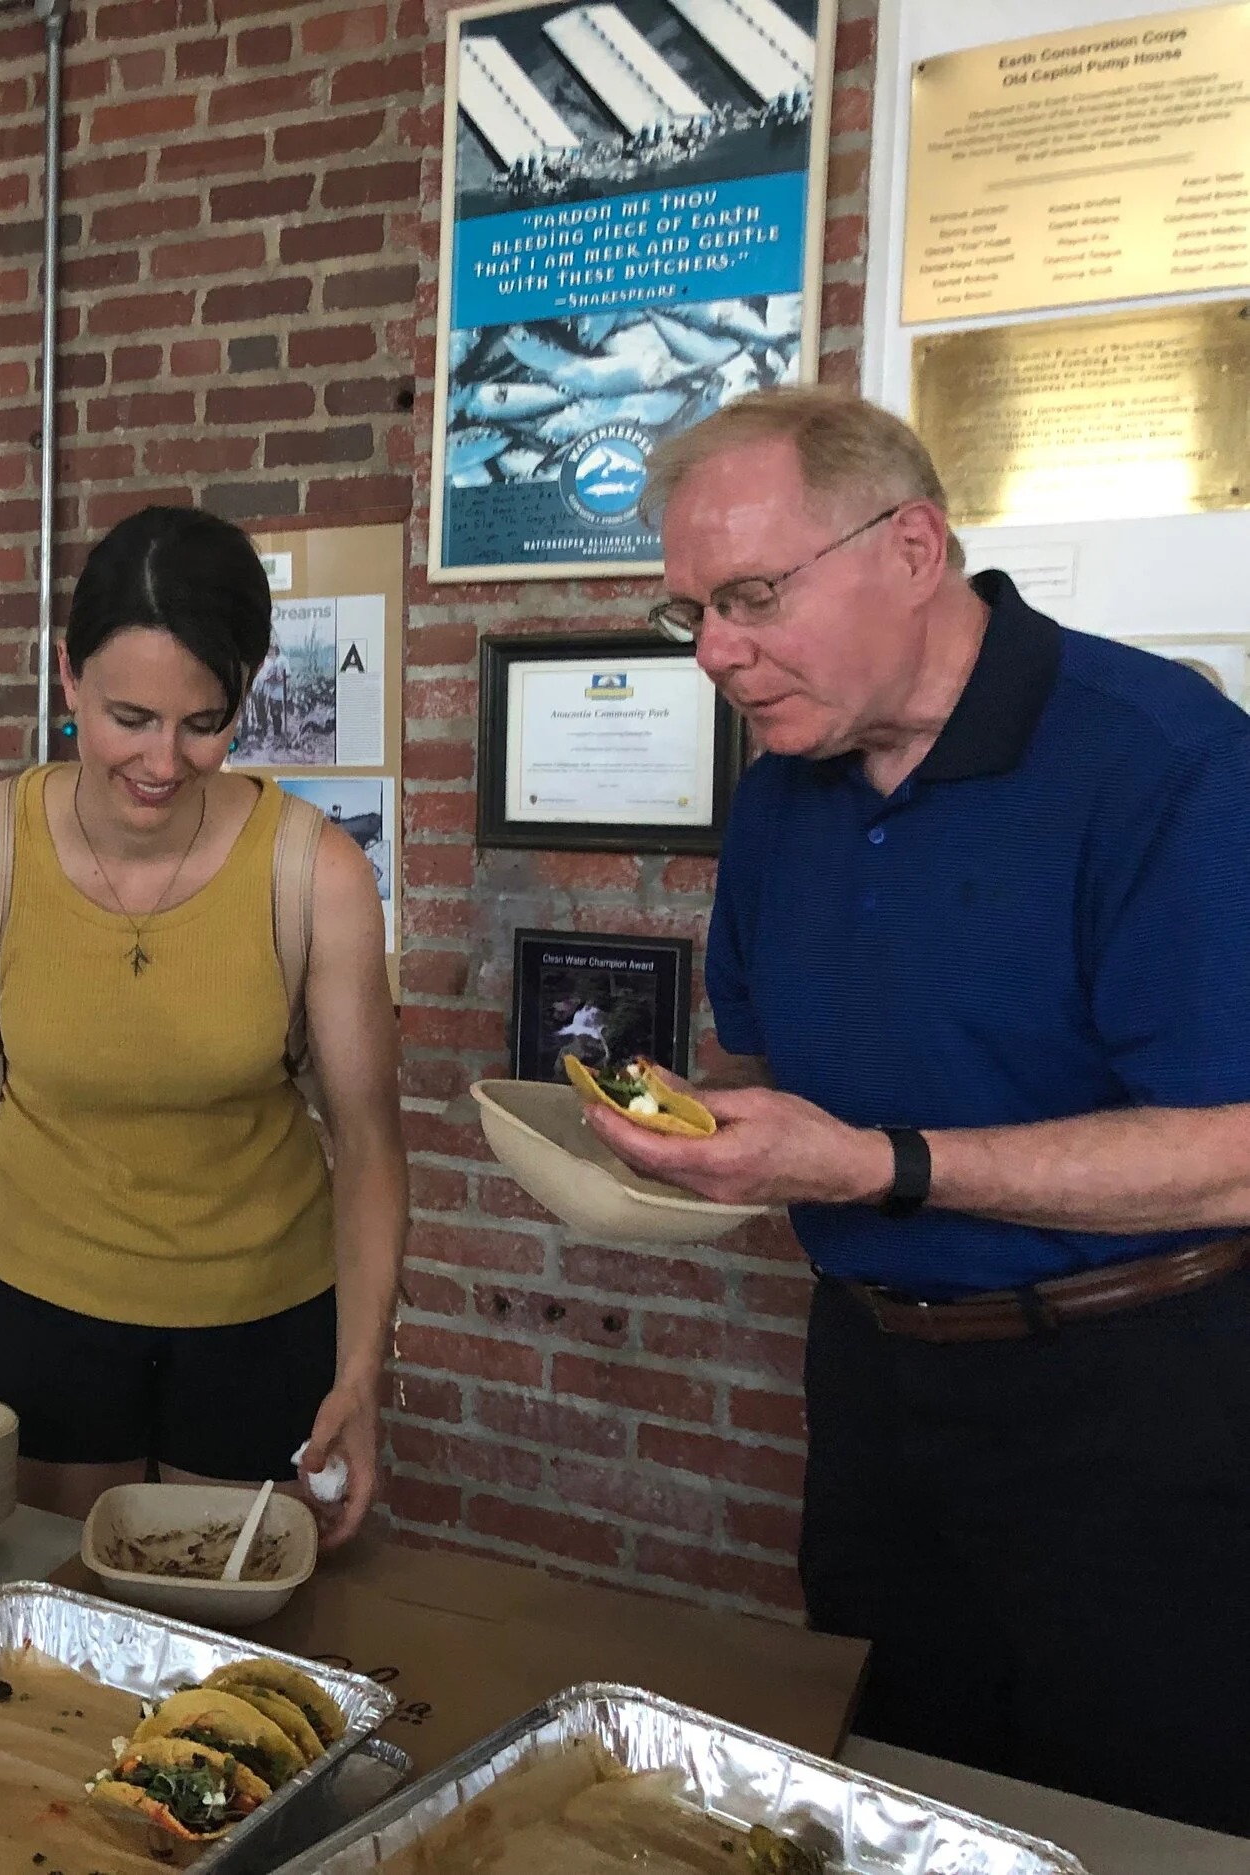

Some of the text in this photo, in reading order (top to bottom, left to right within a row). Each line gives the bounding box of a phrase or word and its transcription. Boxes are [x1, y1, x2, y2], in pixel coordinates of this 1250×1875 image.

[998, 27, 1188, 70] Earth Conservation Corps
[1002, 48, 1182, 88] Old Capitol Pump House
[621, 200, 651, 217] ME
[491, 206, 761, 257] BLEEDING PIECE OF EARTH
[474, 255, 522, 278] THAT
[545, 251, 575, 270] AM
[585, 243, 639, 264] MEEK
[647, 235, 691, 256] AND
[699, 225, 780, 250] GENTLE
[498, 274, 549, 296] WITH
[557, 265, 615, 288] THESE
[339, 641, 365, 674] A
[594, 708, 646, 721] Community
[648, 707, 670, 719] Park
[542, 952, 655, 972] Clean Water Champion Award
